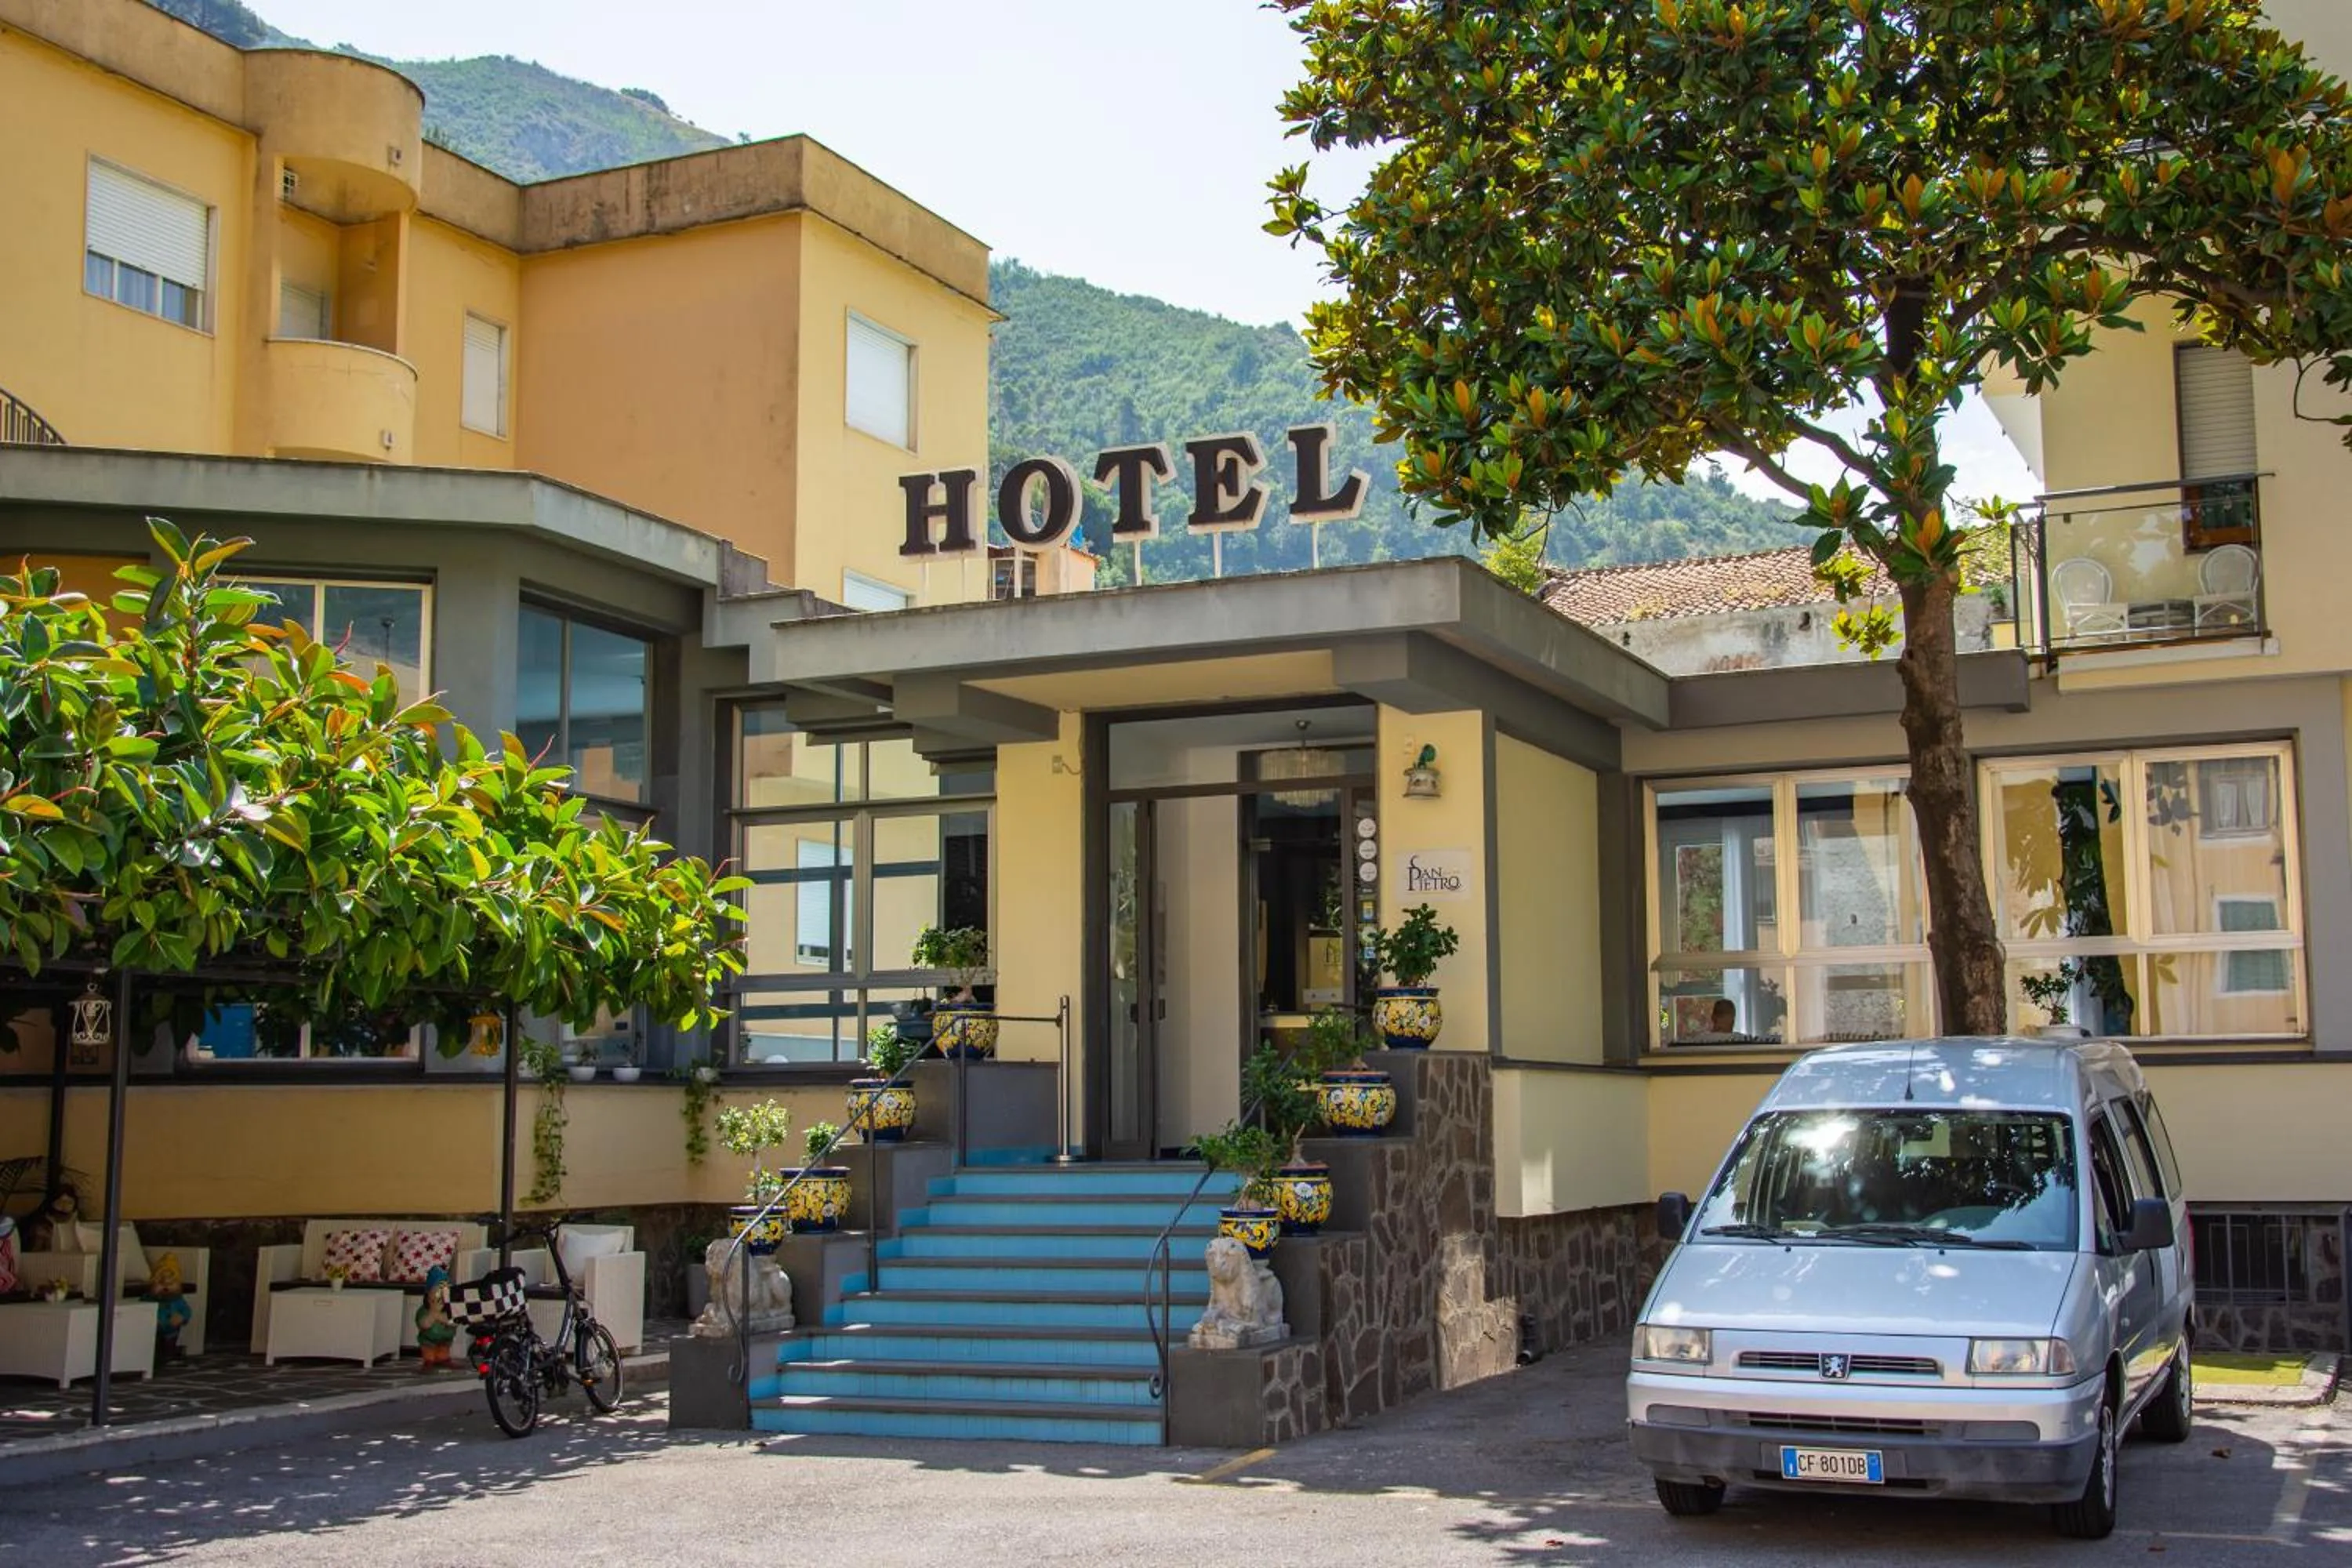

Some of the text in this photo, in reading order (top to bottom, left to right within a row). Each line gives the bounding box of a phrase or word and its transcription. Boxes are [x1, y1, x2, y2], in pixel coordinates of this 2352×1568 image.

[898, 422, 1370, 557] HOTEL
[1798, 1454, 1866, 1475] CF 801DB
